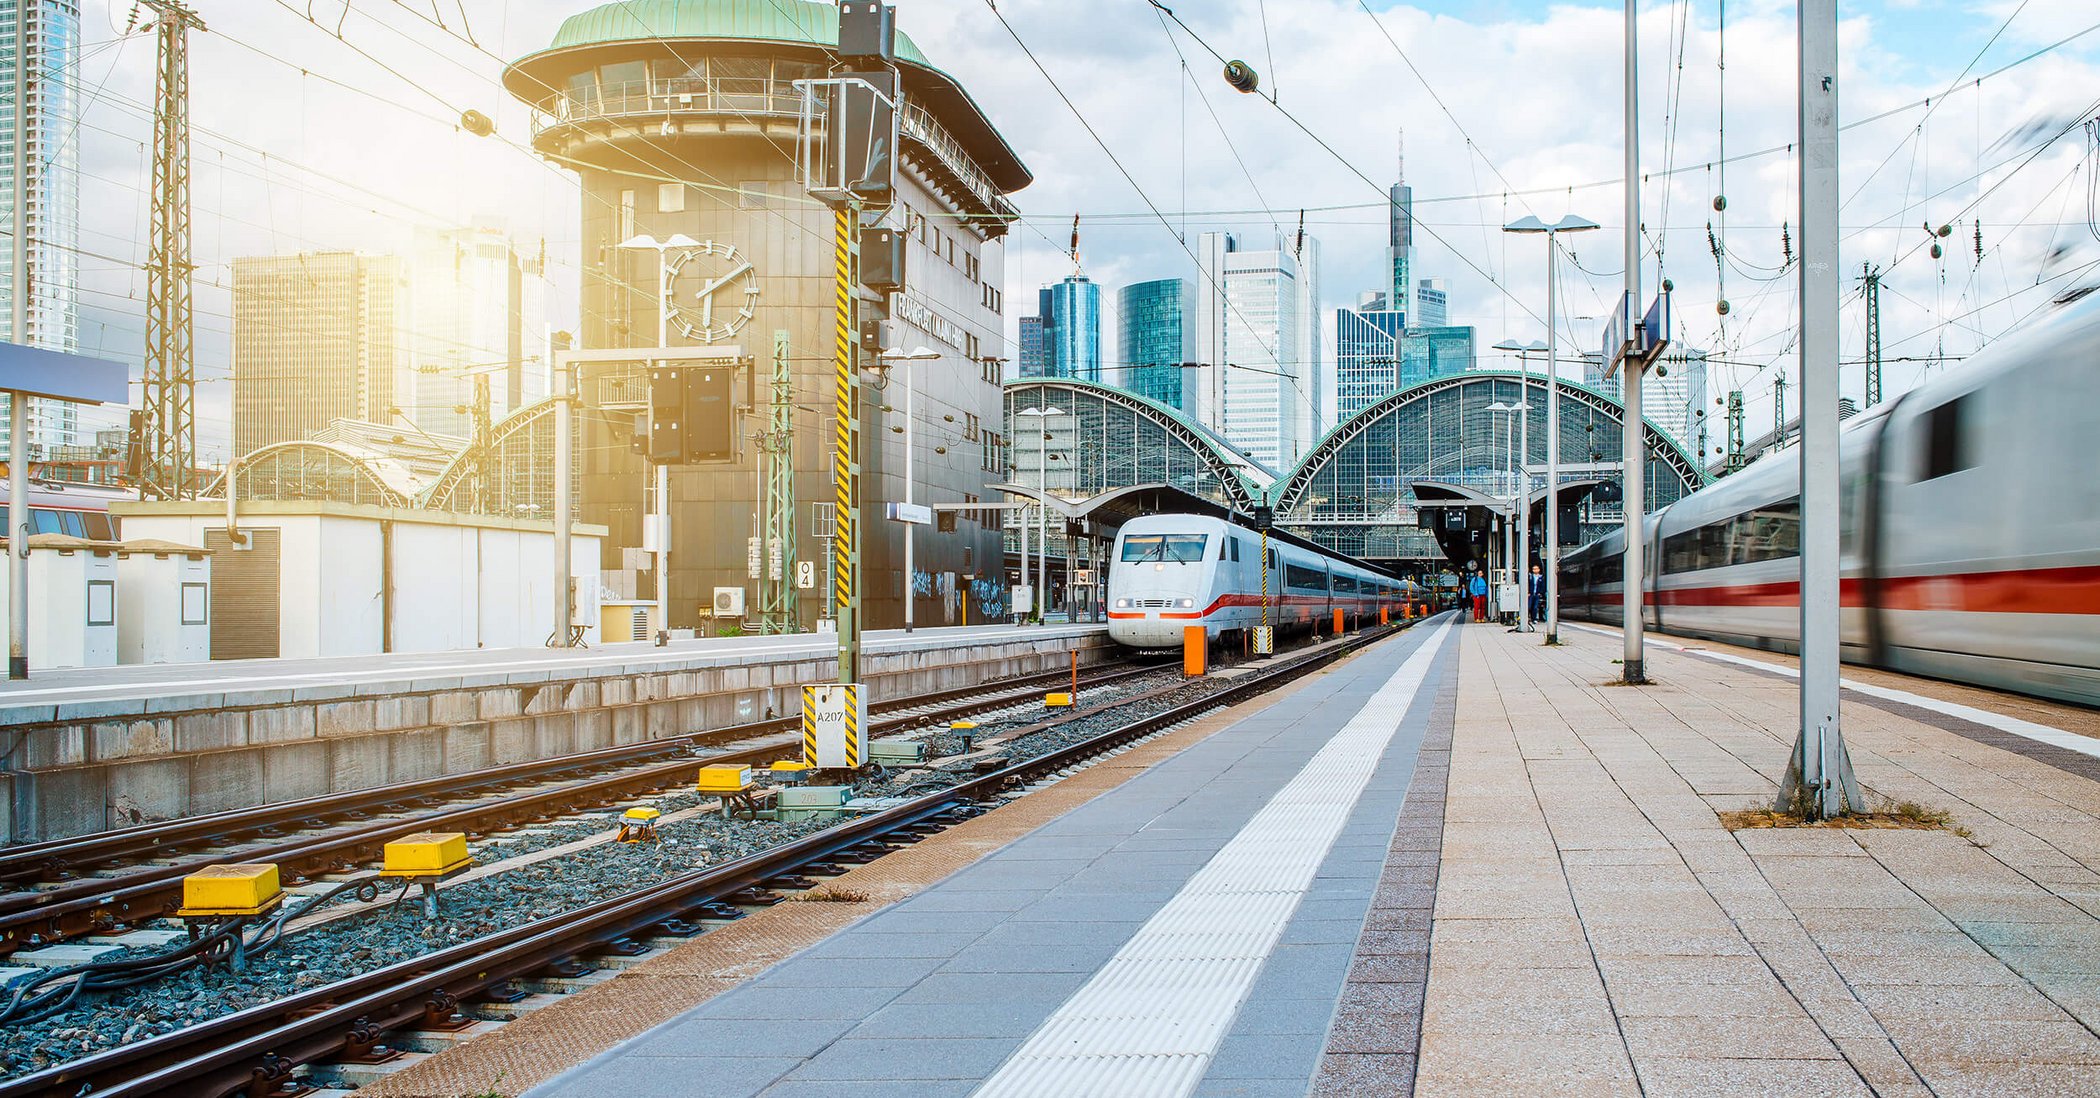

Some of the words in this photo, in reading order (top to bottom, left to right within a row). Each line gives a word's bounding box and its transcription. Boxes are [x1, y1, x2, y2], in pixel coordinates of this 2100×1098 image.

[1471, 530, 1479, 542] F
[801, 575, 810, 587] 4
[817, 711, 844, 722] A207
